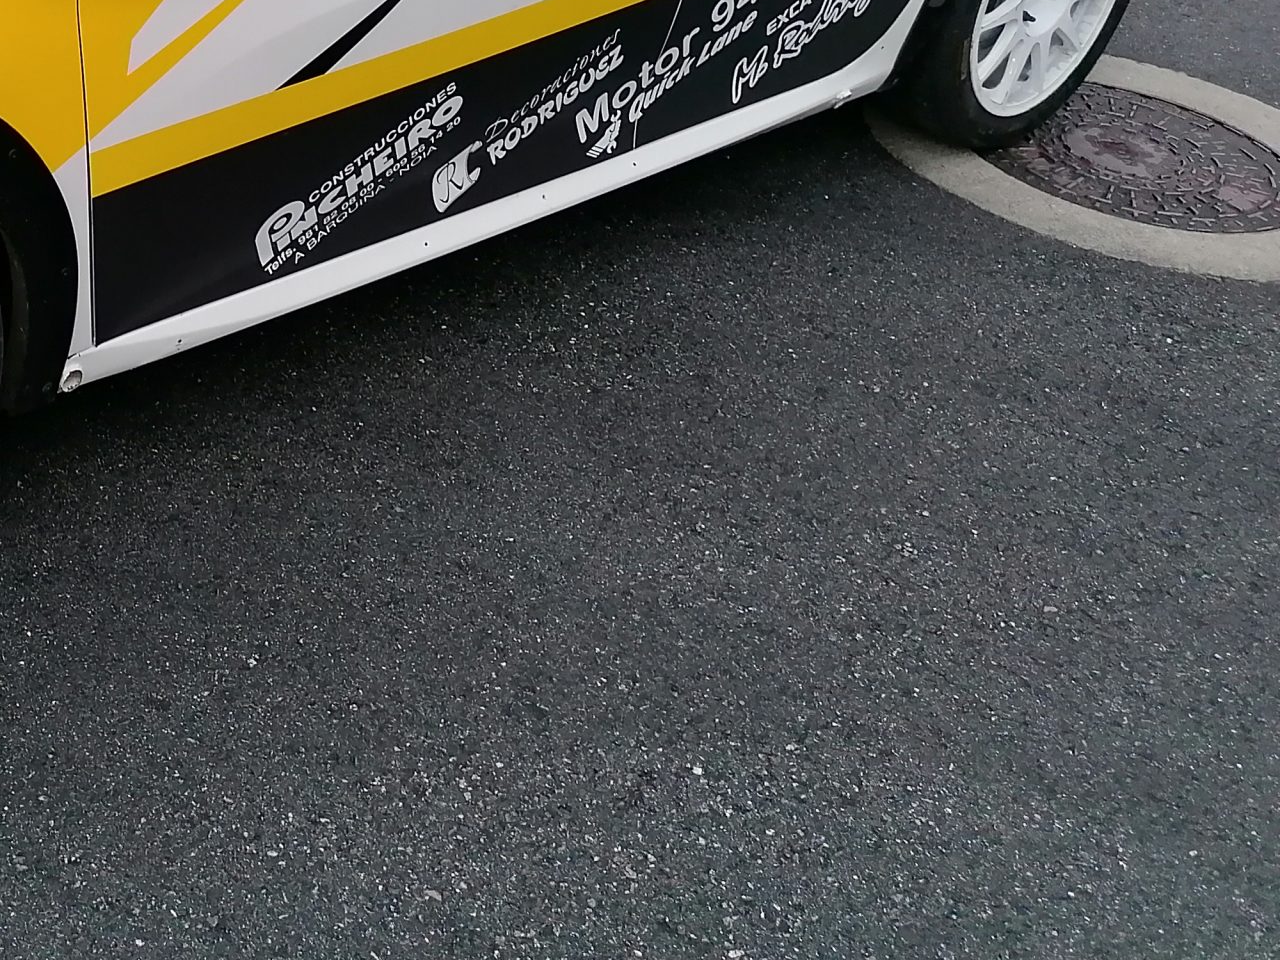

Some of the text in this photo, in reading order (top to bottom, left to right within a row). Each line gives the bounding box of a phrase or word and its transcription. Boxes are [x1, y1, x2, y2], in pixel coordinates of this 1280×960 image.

[485, 28, 621, 143] Decoraciones
[575, 27, 701, 143] Motor
[628, 11, 758, 123] Quick Lane
[255, 95, 464, 268] PINCHEIRO
[297, 226, 319, 244] 981
[323, 209, 339, 224] 82
[341, 195, 357, 211] 08
[359, 182, 376, 197] 00
[385, 157, 408, 177] 609
[410, 145, 426, 159] 56
[431, 131, 444, 144] 14
[446, 116, 462, 132] 20
[308, 81, 458, 203] CONSTRUCCIONES
[294, 251, 305, 264] A
[306, 184, 386, 250] BARQUINA
[399, 145, 438, 177] NOIA
